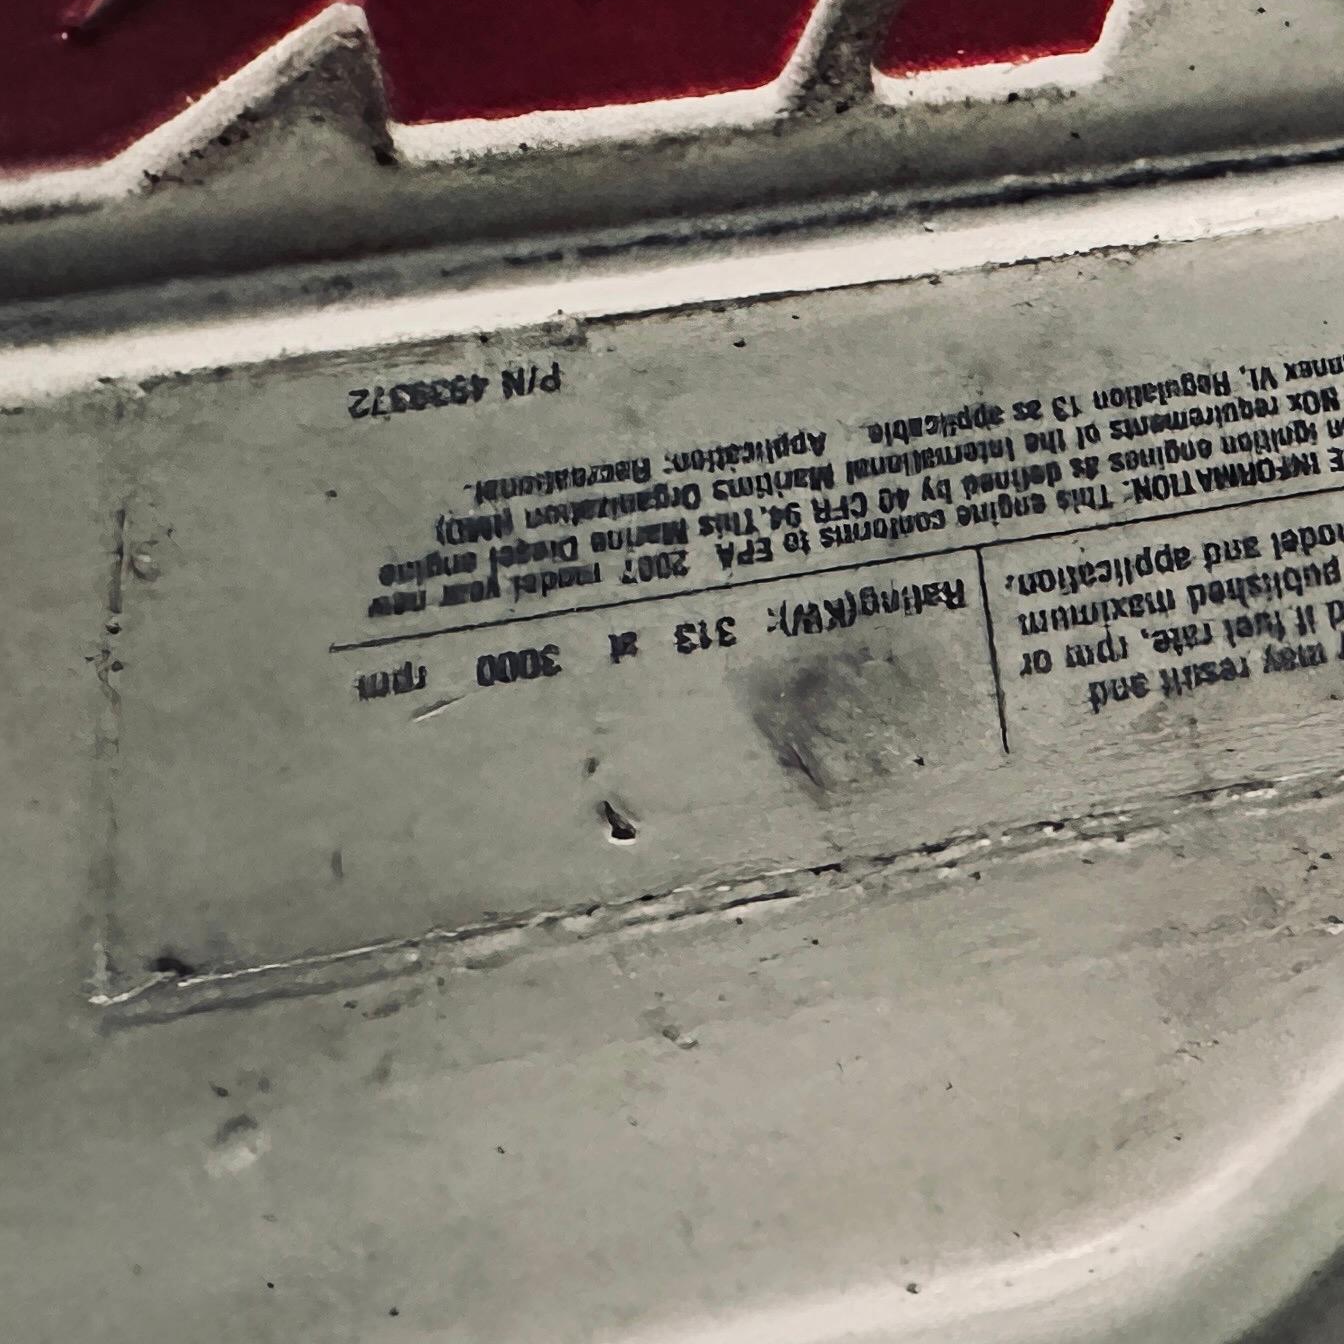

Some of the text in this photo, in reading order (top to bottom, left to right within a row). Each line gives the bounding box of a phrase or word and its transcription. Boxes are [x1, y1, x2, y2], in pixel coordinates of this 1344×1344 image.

[503, 363, 560, 398] P/N
[1094, 372, 1230, 409] Regulation
[1013, 401, 1042, 420] as
[1052, 397, 1081, 421] 13
[1288, 387, 1339, 414] NOx
[1110, 397, 1278, 439] requirements
[664, 431, 825, 473] Application:
[1025, 430, 1065, 453] the
[1077, 423, 1100, 449] of
[1221, 421, 1317, 454] ignition
[847, 438, 1014, 484] International
[1109, 440, 1211, 471] engines
[923, 477, 952, 503] by
[962, 462, 1061, 499] defined
[1123, 453, 1320, 503] INFORMATION:
[812, 493, 867, 522] CFR
[880, 489, 909, 513] 40
[957, 494, 1046, 525] engine
[1057, 485, 1112, 513] This
[592, 519, 687, 551] Marine
[784, 530, 810, 554] to
[820, 510, 945, 547] conforms
[621, 550, 688, 583] 2007
[716, 538, 772, 569] EPA
[1006, 545, 1191, 595] application.
[1204, 537, 1260, 572] and
[1188, 557, 1340, 614] published
[1019, 590, 1175, 634] maximum
[1224, 607, 1285, 647] fuel
[1290, 606, 1315, 635] if
[609, 633, 637, 663] at
[676, 618, 735, 653] 313
[1067, 631, 1127, 667] rpm
[1142, 624, 1212, 655] rate,
[478, 645, 561, 685] 3000
[1021, 650, 1051, 676] or
[1264, 644, 1326, 672] may
[357, 663, 425, 699] rpm
[1089, 674, 1149, 713] and
[1161, 658, 1249, 697] result
